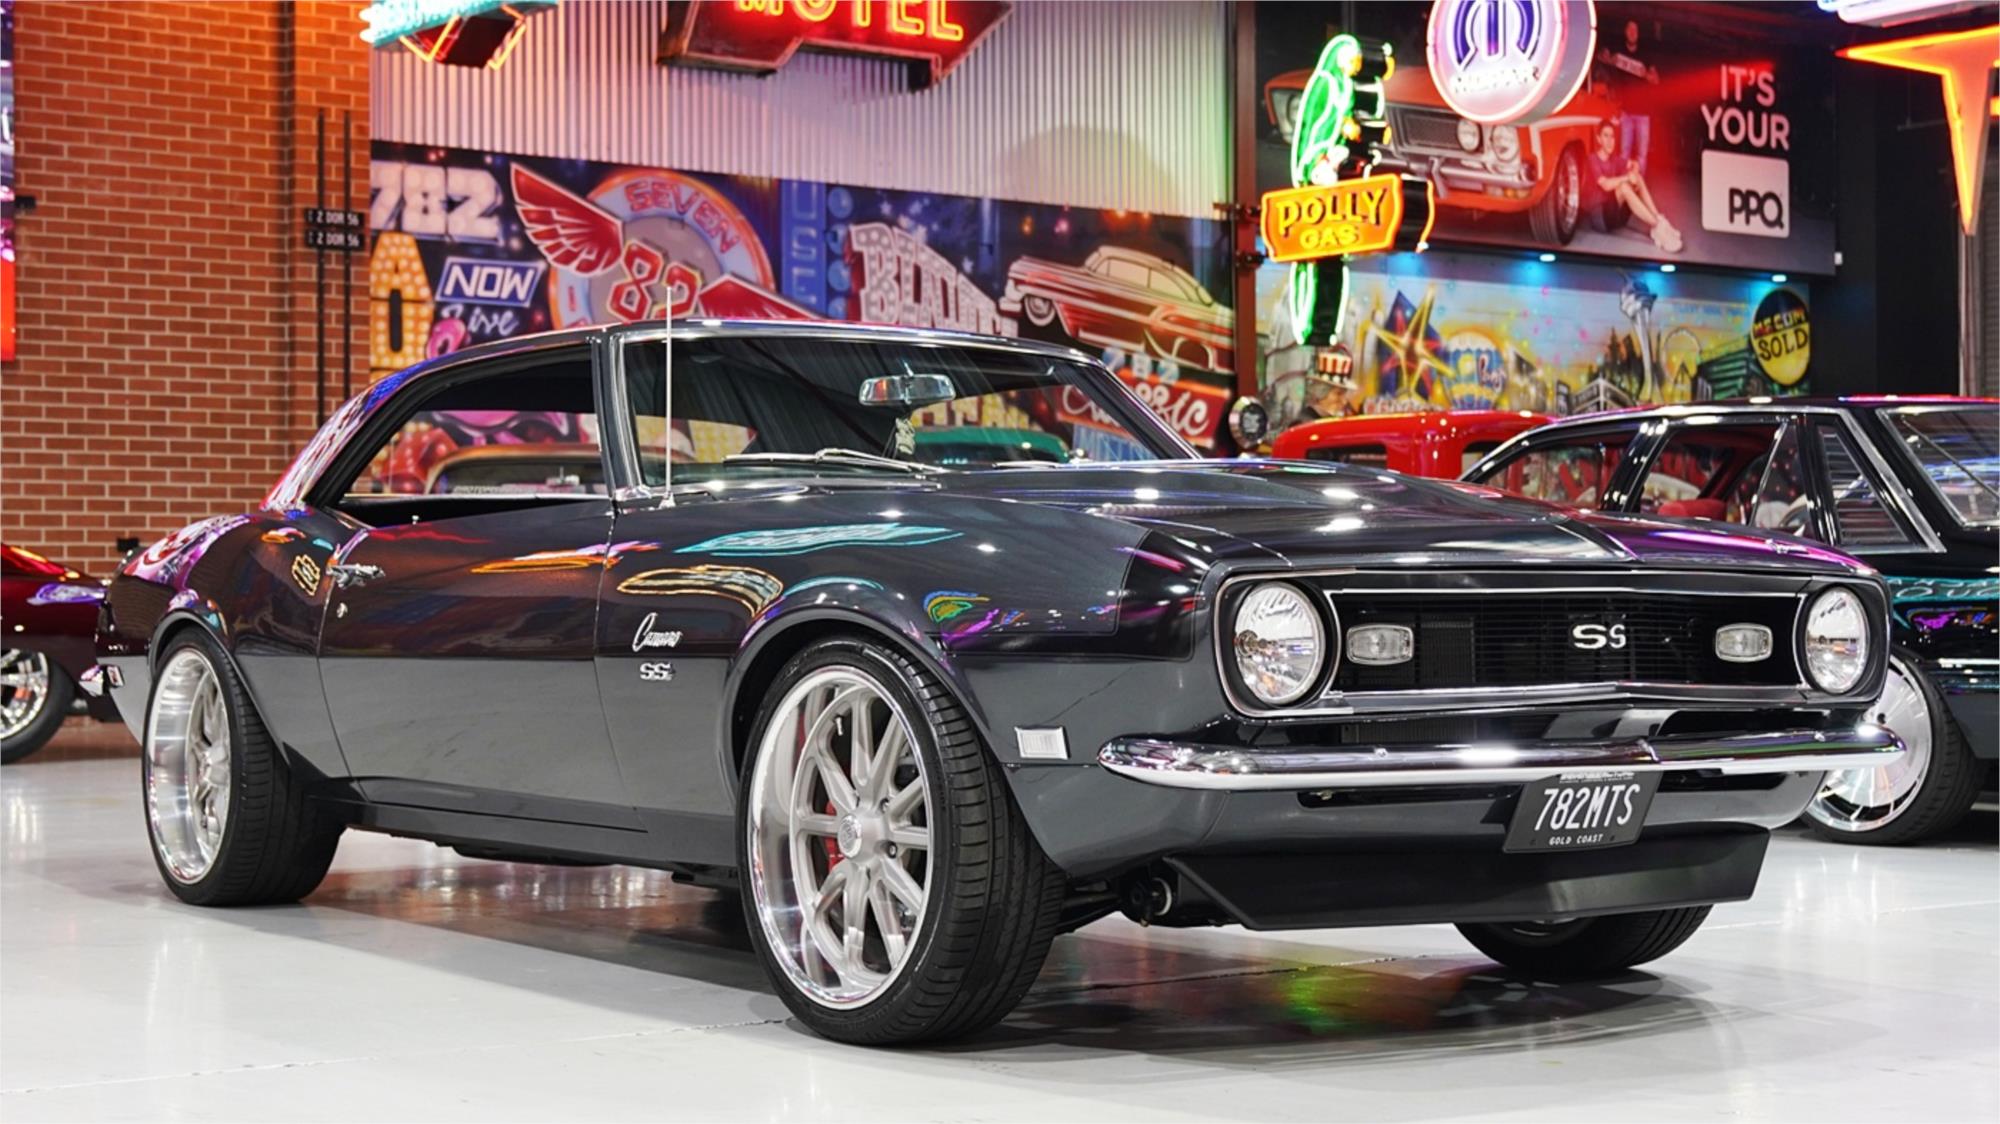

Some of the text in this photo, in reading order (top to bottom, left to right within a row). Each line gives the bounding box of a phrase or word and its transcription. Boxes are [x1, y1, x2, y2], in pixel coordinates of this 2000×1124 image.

[1720, 64, 1776, 107] IT'S
[1700, 104, 1790, 151] YOUR
[370, 161, 503, 246] 782
[624, 180, 740, 254] SEVEN
[1275, 187, 1388, 238] POLLY
[1728, 187, 1785, 230] PPQ
[1300, 224, 1358, 250] GAS
[444, 264, 535, 301] NOW
[607, 239, 701, 324] 82
[1757, 328, 1809, 362] SOLD
[1573, 624, 1627, 649] SS
[1534, 783, 1641, 831] 782MTS
[1549, 833, 1604, 846] GOLD COAST
